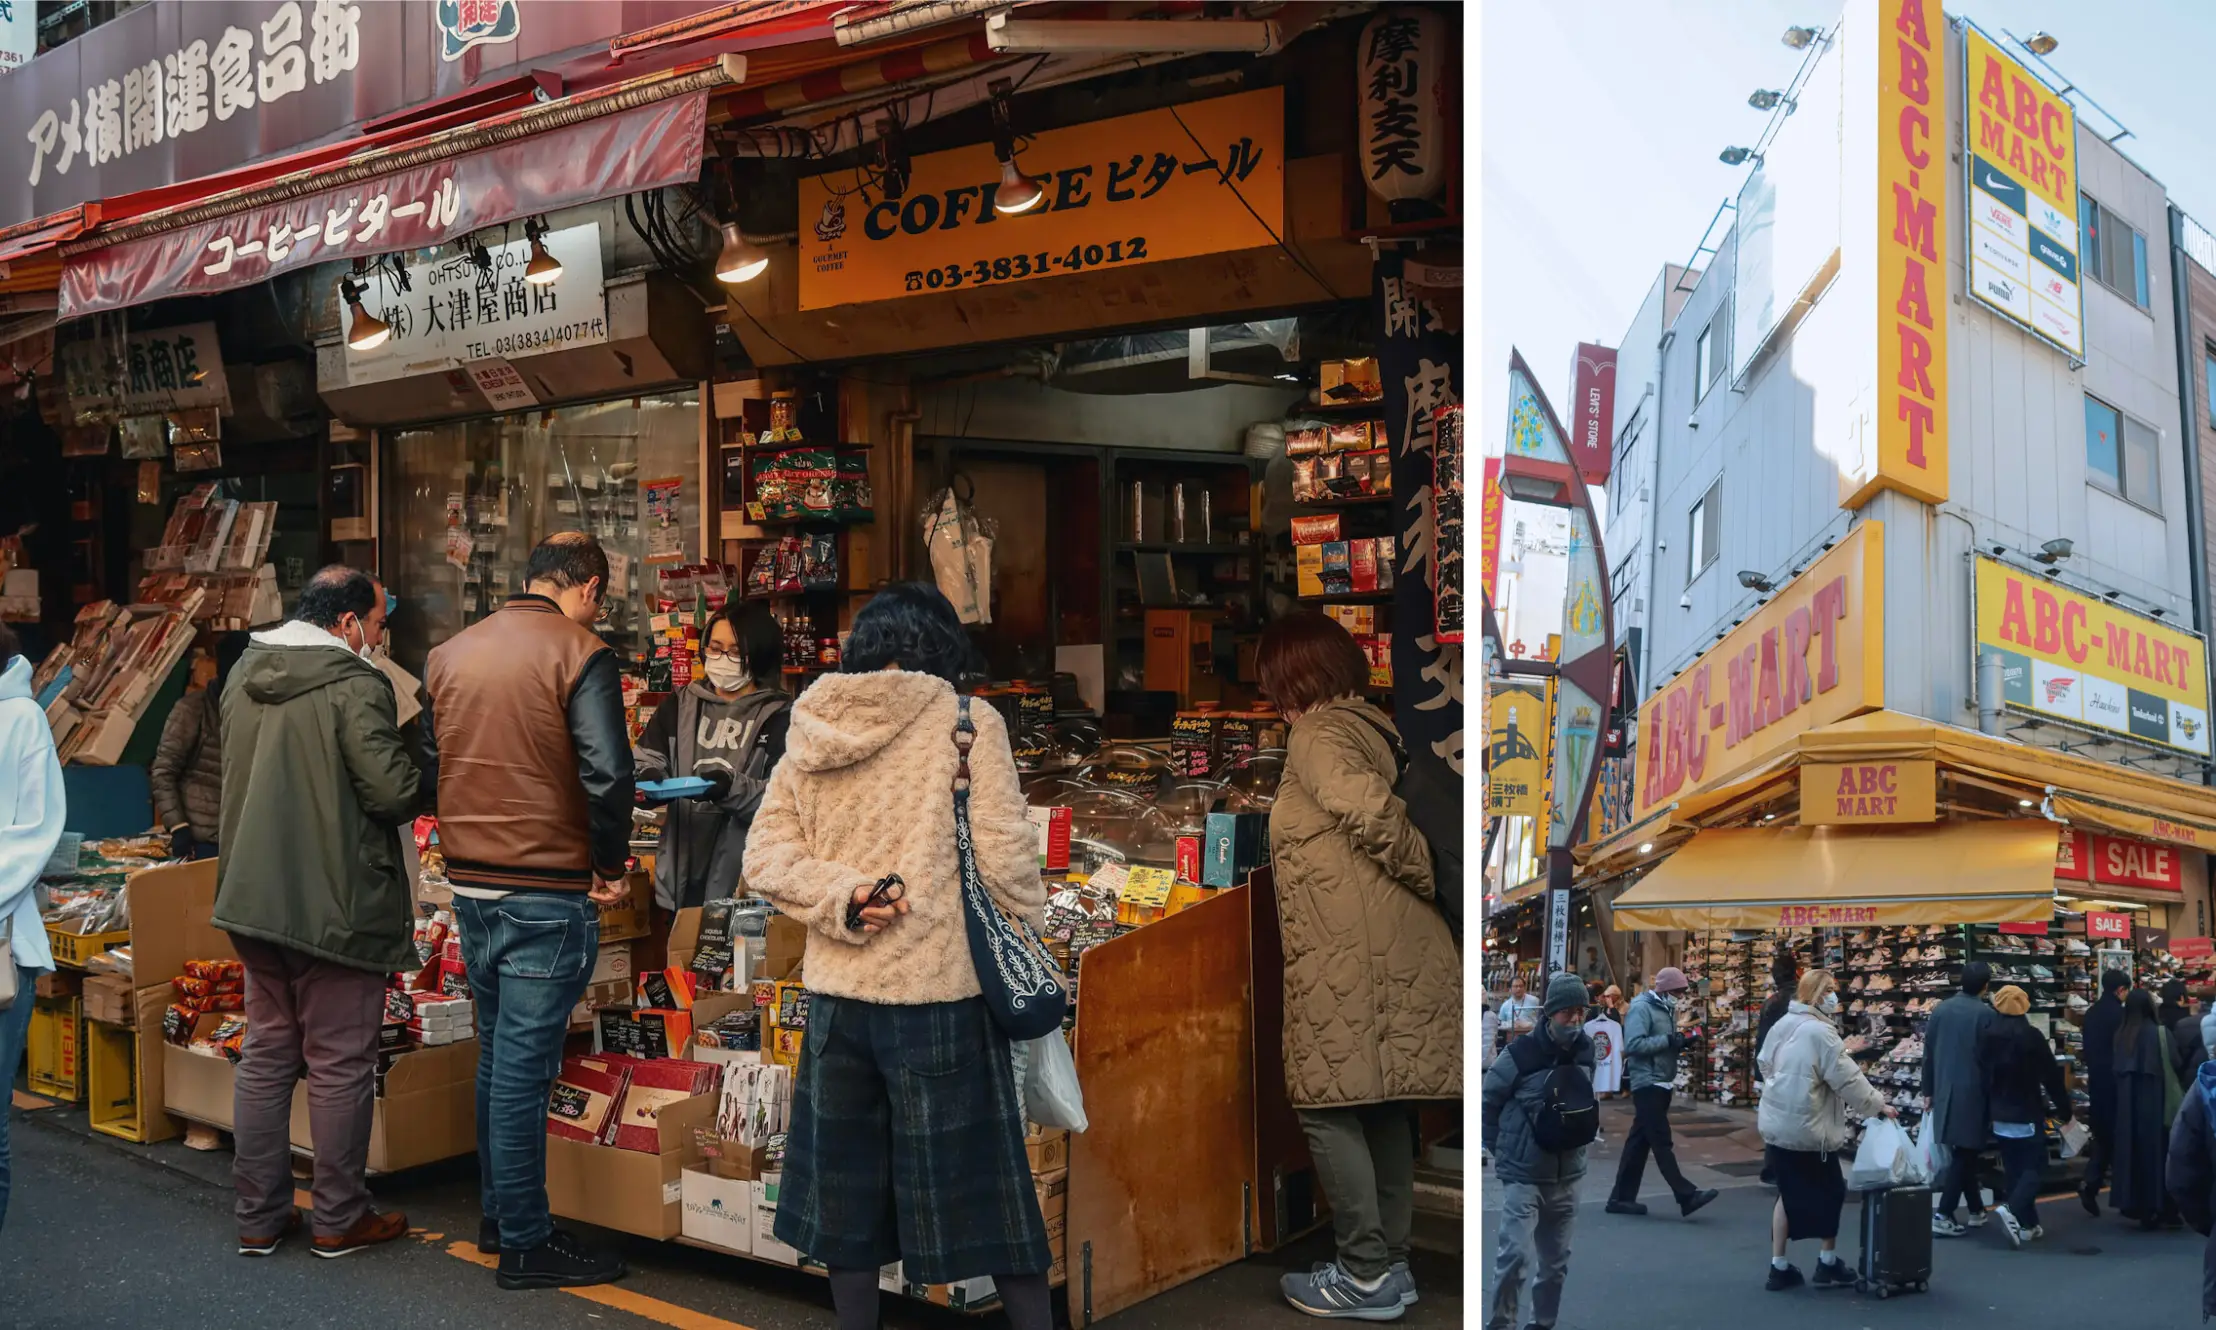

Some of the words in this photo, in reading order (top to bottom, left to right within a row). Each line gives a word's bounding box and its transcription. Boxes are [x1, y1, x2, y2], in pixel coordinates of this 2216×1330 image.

[27, 0, 362, 187] アメ横開運食品街
[1366, 17, 1424, 181] 摩利支天
[1979, 52, 2066, 161] ABC
[1105, 137, 1264, 203] ビタール
[1979, 108, 2068, 204] MART
[203, 176, 462, 276] コーヒービタール
[1892, 0, 1938, 470] ABC-MART
[1990, 206, 2013, 229] VANS
[422, 275, 558, 338] 大津屋商店
[1586, 420, 1599, 449] STORE
[1999, 577, 2190, 692] ABC-MART
[1642, 574, 1848, 809] ABC-MART
[1836, 764, 1898, 796] ABC
[1836, 796, 1898, 817] MART
[2107, 842, 2171, 882] SALE
[2152, 820, 2196, 842] ABC-MART
[1778, 906, 1877, 926] ABC-MART
[2096, 916, 2123, 933] SALE
